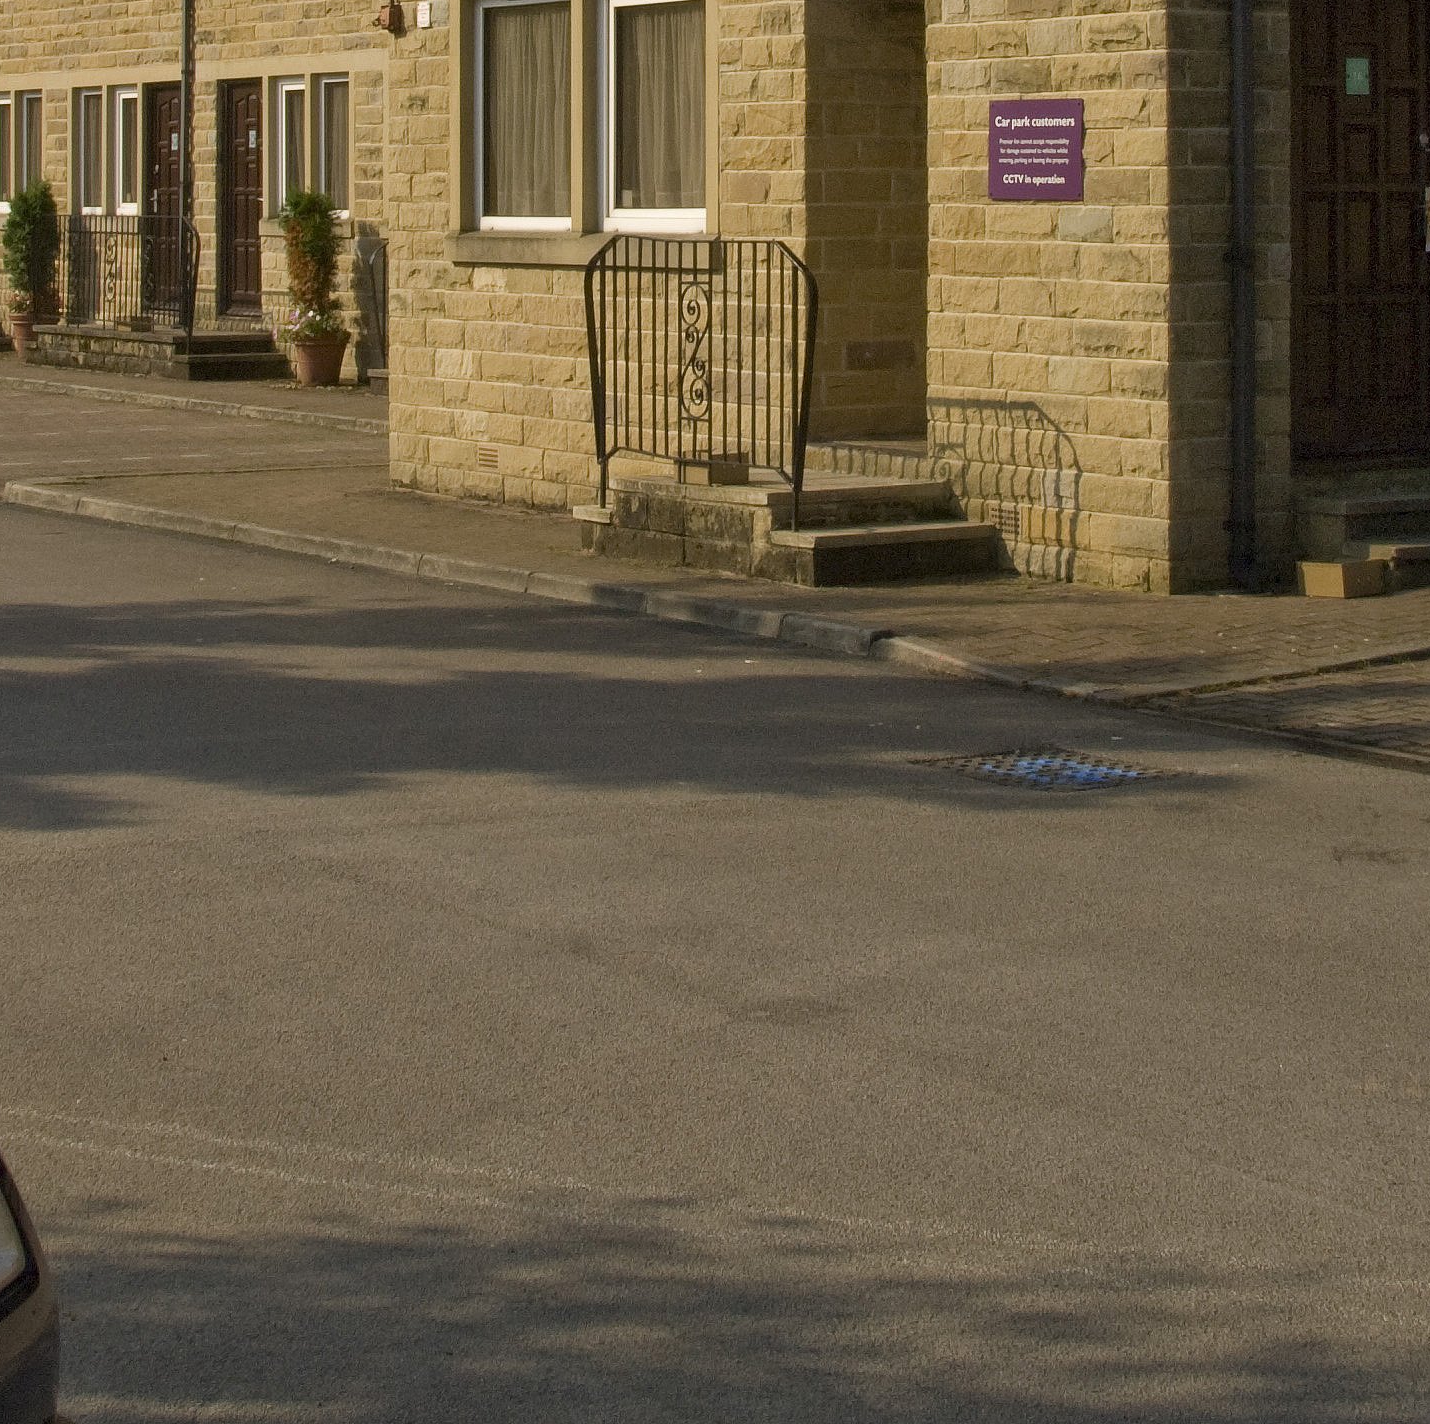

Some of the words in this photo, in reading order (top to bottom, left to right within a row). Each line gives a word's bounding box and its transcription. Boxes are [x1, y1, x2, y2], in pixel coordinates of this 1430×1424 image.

[994, 116, 1010, 128] Car
[1011, 116, 1031, 130] park
[1031, 117, 1075, 128] customers
[1002, 174, 1024, 184] CCTV
[1024, 174, 1032, 184] in
[1032, 174, 1066, 187] operation
